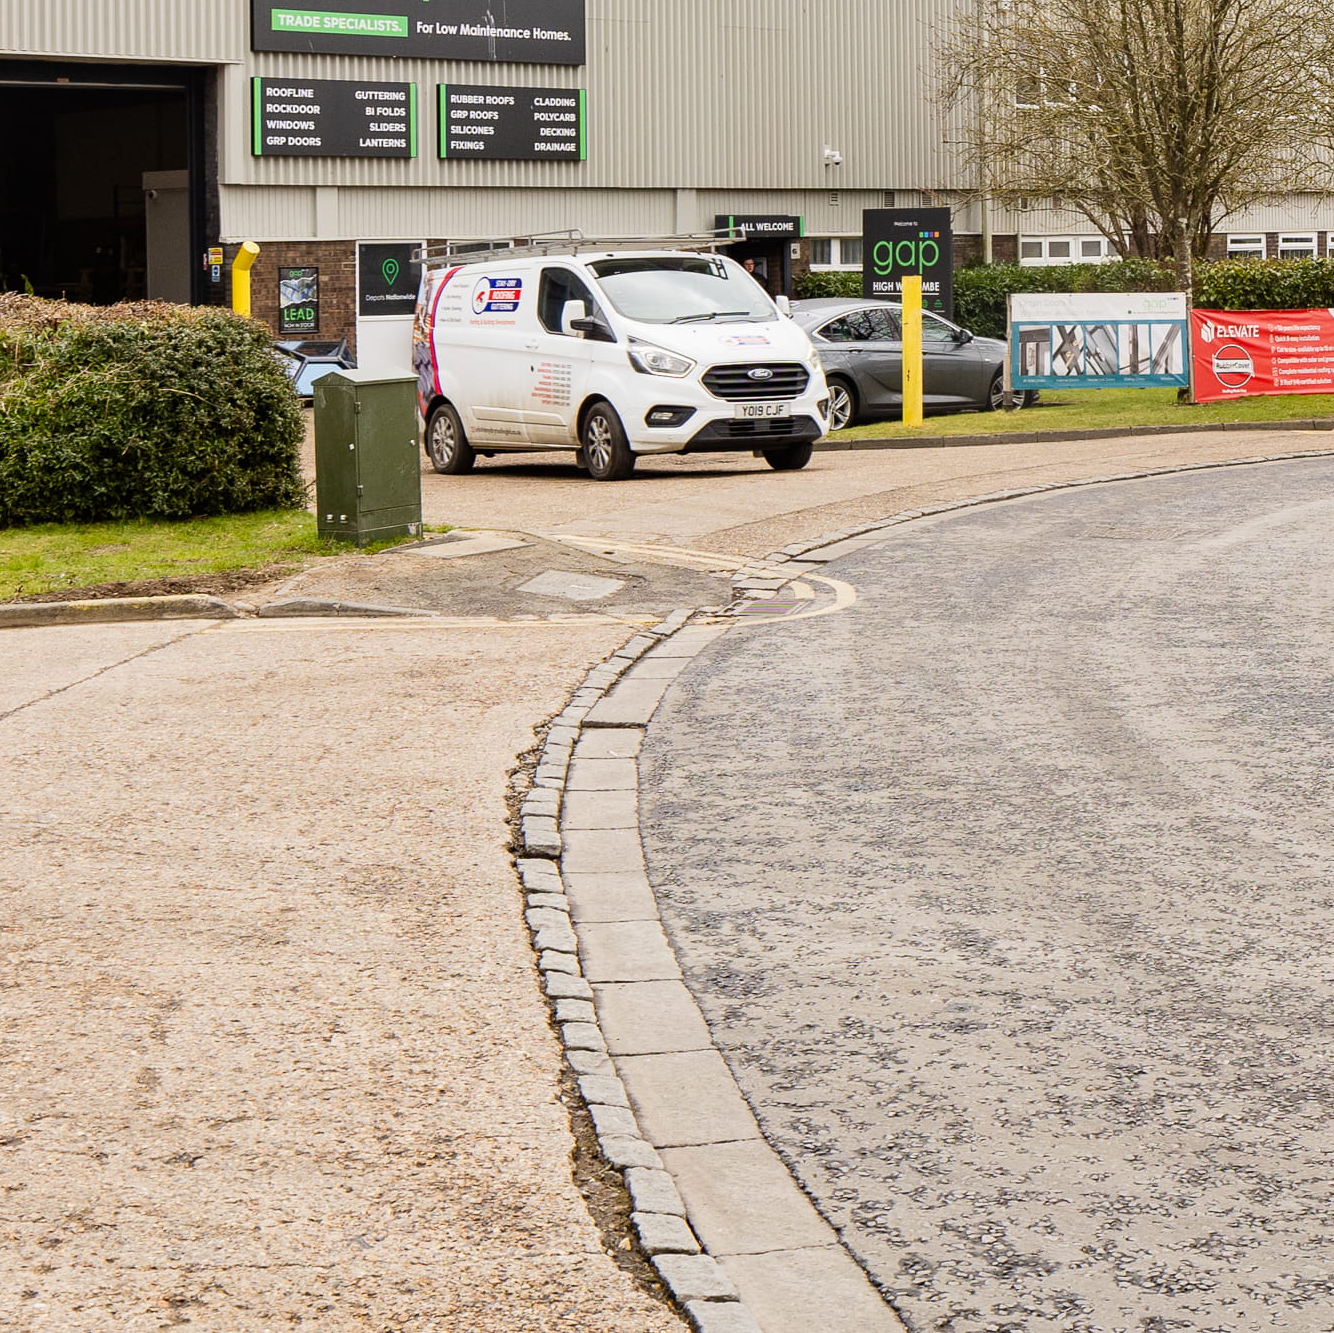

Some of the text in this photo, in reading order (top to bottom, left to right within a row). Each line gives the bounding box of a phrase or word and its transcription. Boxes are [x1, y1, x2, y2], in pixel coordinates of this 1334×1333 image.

[277, 14, 403, 32] TRADE SPECIALISTS.
[417, 21, 572, 41] For Low Maintenance Homes.
[266, 88, 314, 98] ROOFLINE
[355, 91, 406, 100] GUTTERING
[450, 94, 515, 105] RUBBER ROOFS
[534, 98, 576, 106] CLADDING
[266, 104, 320, 114] ROCKDOOR
[365, 107, 406, 116] BI FOLDS
[450, 110, 499, 120] GRP ROOFS
[534, 113, 576, 121] POLYCARB
[266, 120, 315, 130] WINDOWS
[369, 122, 406, 132] SLIDERS
[450, 126, 495, 135] SILICONES
[540, 128, 576, 136] DECKING
[266, 136, 322, 146] GRP DOORS
[359, 138, 407, 147] LANTERNS
[450, 141, 485, 150] FIXINGS
[534, 143, 576, 151] DRAINAGE
[756, 223, 794, 231] WELCOME
[873, 240, 939, 276] gap
[873, 282, 940, 291] HIGH WMBE
[283, 308, 315, 321] LEAD
[1217, 324, 1260, 338] ELEVATE
[766, 405, 784, 416] CJF
